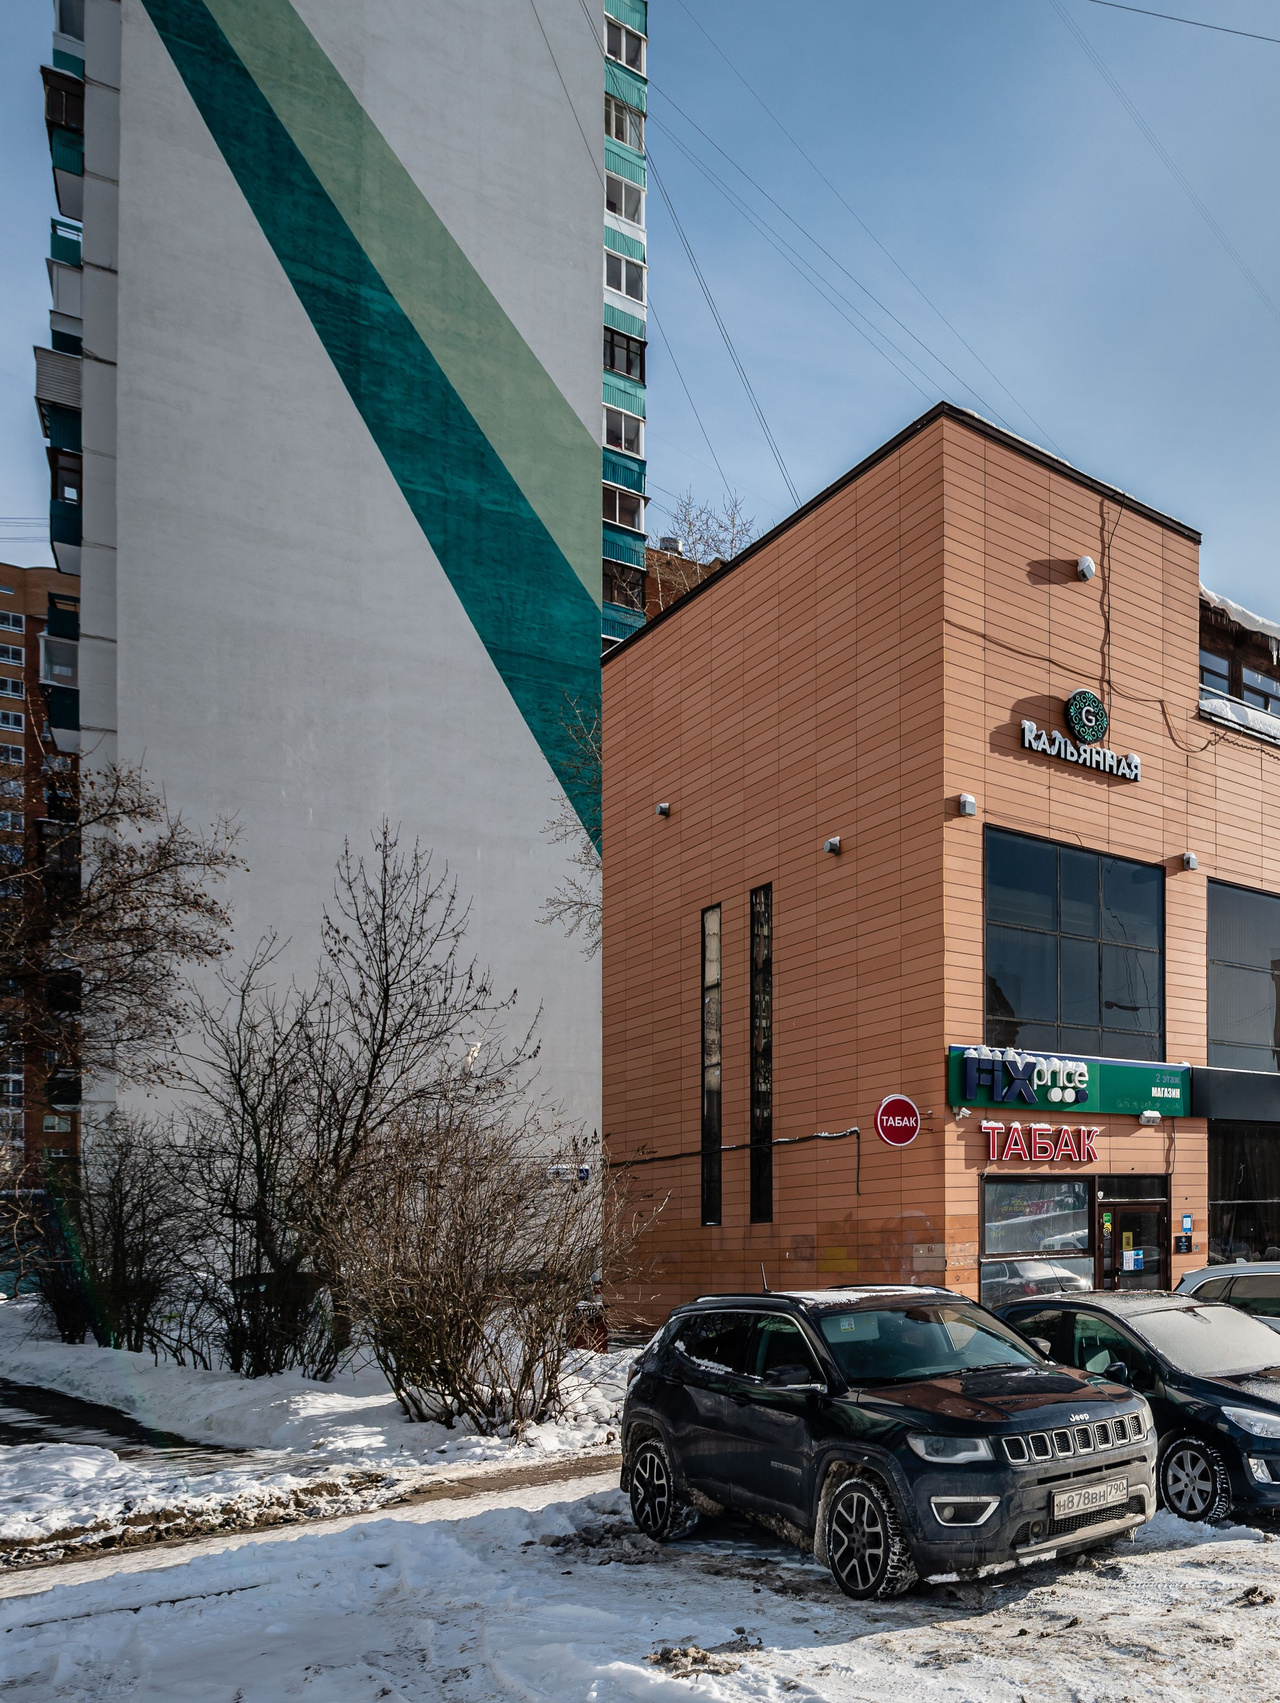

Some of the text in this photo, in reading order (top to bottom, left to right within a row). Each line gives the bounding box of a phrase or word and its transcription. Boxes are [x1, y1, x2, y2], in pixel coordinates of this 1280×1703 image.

[965, 1056, 1038, 1103] FIX
[1155, 1073, 1180, 1084] 2 этаж
[1151, 1086, 1181, 1098] МАГАЗИН
[881, 1116, 917, 1127] ТАБАК
[981, 1125, 1100, 1161] ТАБАК
[1069, 1413, 1090, 1422] Jeep
